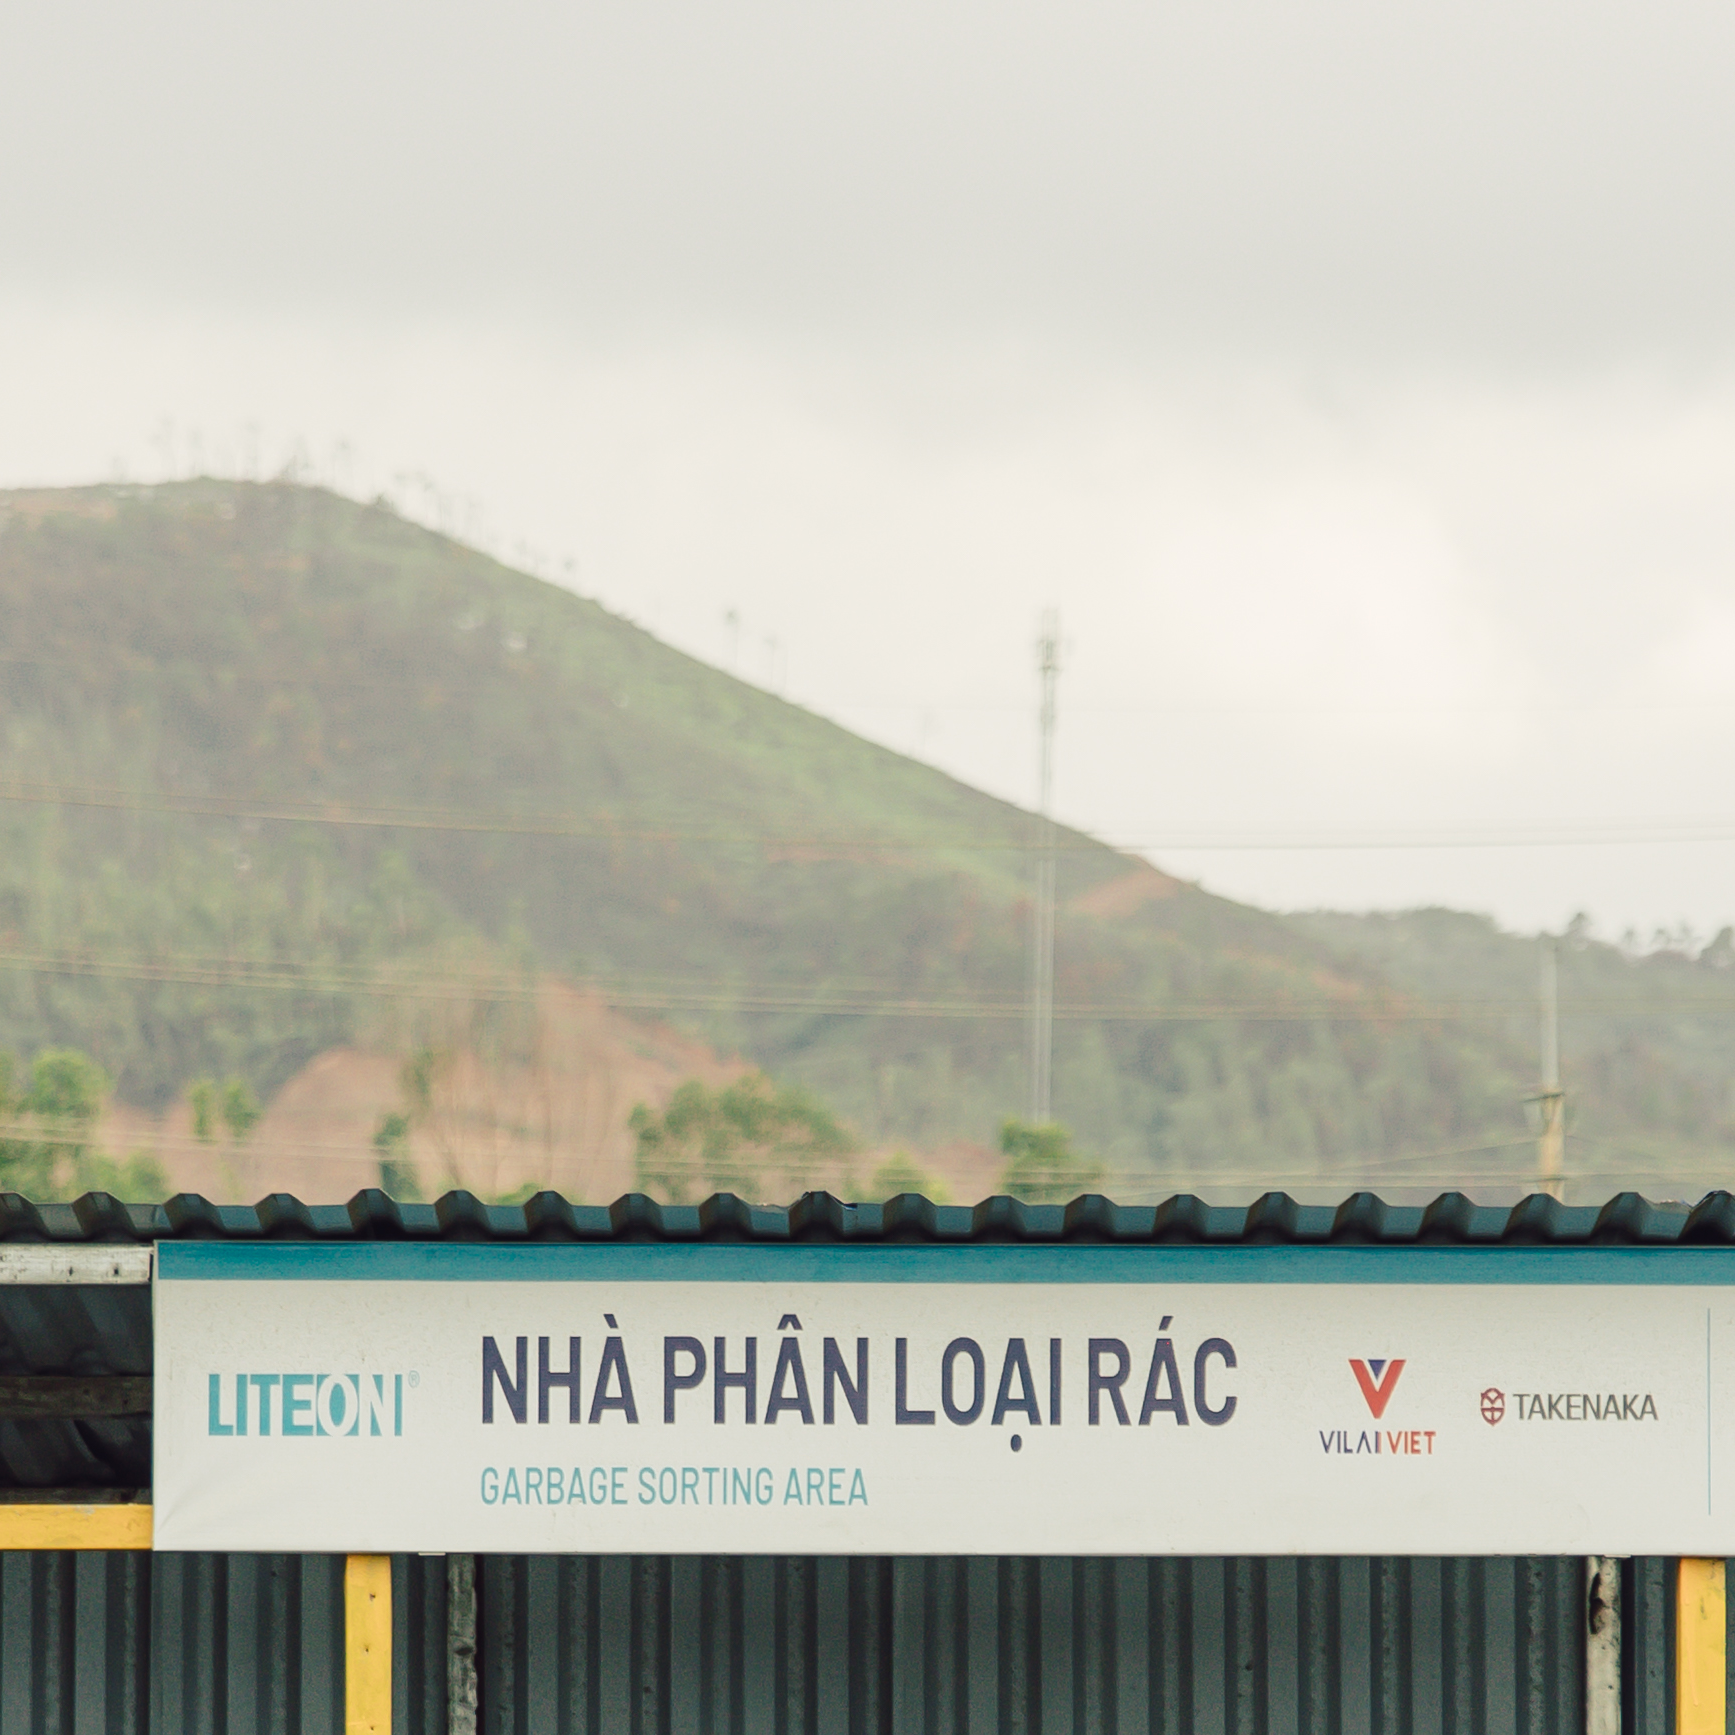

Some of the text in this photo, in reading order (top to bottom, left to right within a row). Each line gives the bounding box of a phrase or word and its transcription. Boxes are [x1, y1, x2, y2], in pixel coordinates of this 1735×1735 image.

[481, 1313, 1238, 1452] NHÀ PHÂN LOẠI RÁC
[1513, 1393, 1659, 1421] TAKENAKA
[481, 1466, 868, 1506] GARBAGE SORTING AREA
